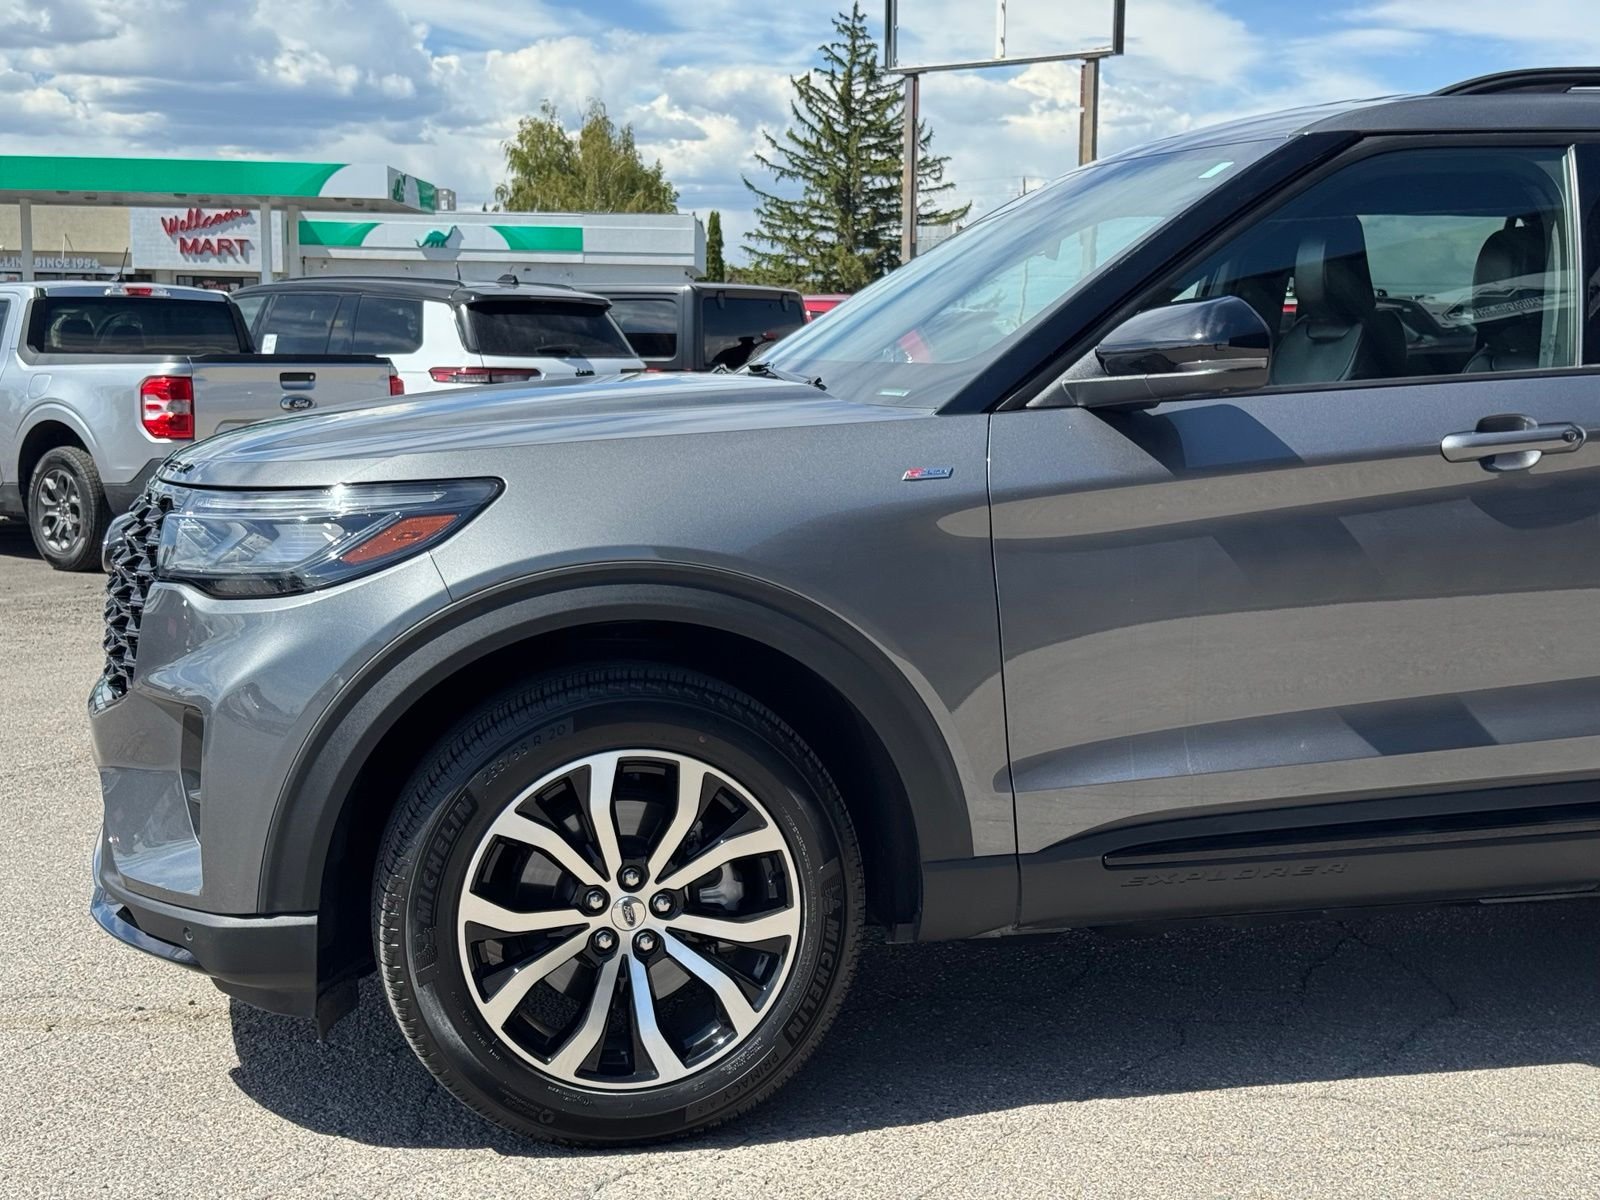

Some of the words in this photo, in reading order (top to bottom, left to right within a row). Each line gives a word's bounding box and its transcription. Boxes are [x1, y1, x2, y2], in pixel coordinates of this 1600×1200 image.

[180, 237, 250, 256] MART
[34, 256, 70, 268] SINCE
[72, 256, 99, 268] 1954
[416, 795, 474, 923] MICHELIN
[1120, 863, 1349, 887] EXPLORER
[789, 919, 840, 1042] MICHELIN
